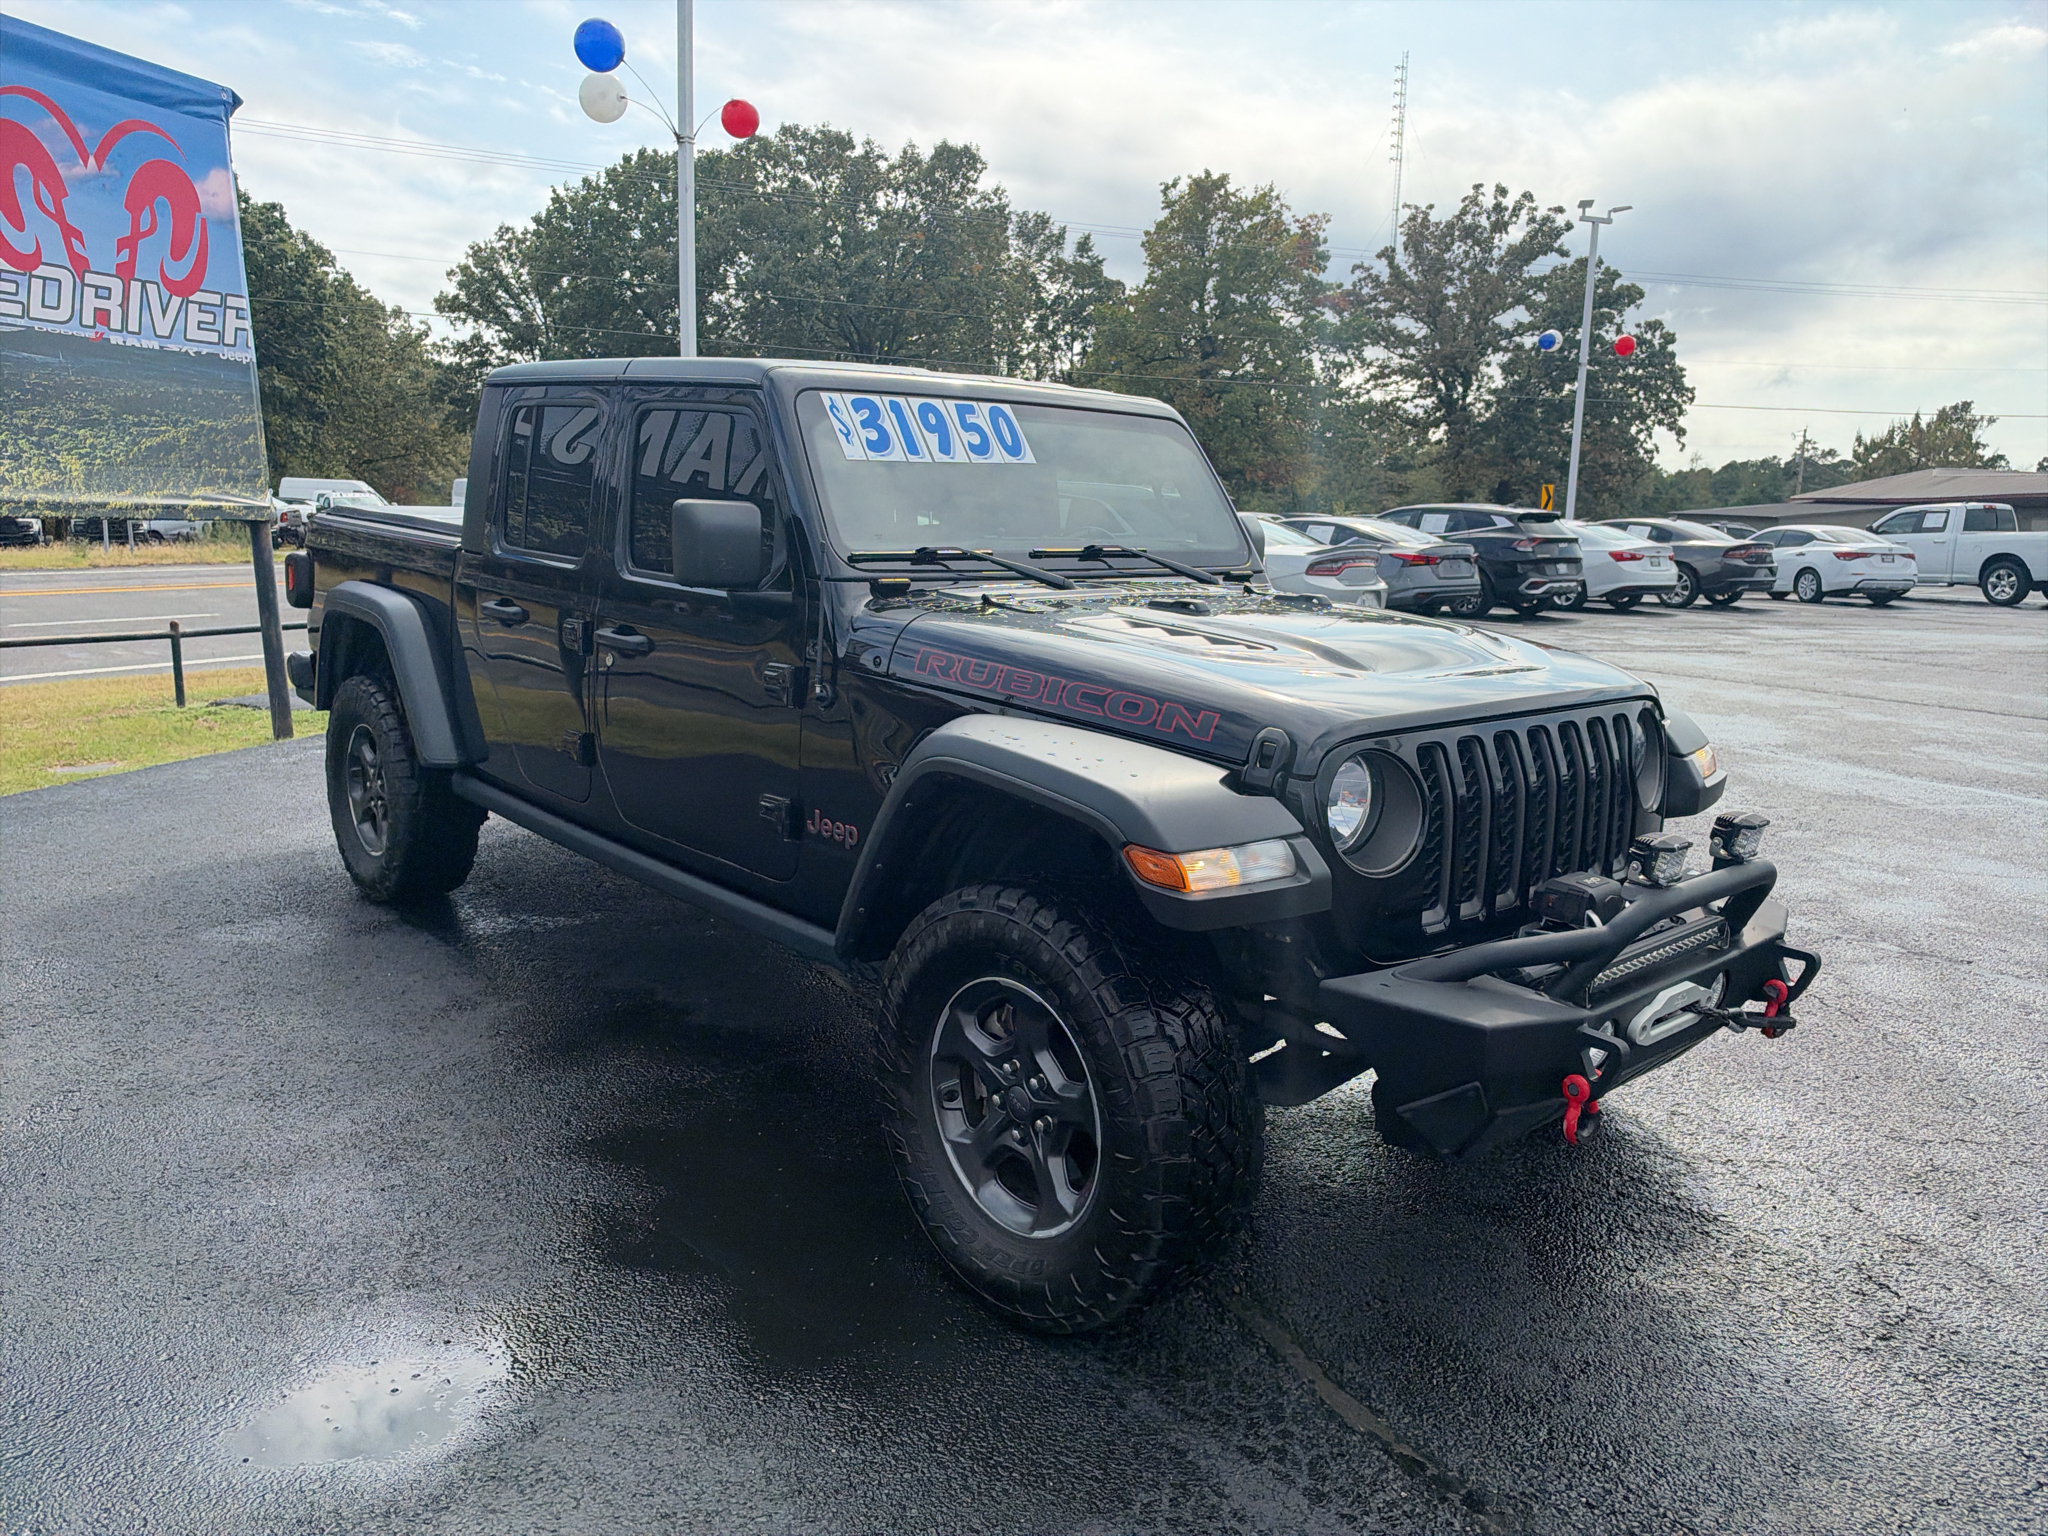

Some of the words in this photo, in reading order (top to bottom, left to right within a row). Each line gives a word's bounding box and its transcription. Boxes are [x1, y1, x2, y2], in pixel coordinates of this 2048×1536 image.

[110, 335, 160, 350] RAM
[219, 347, 250, 364] Jeep
[828, 395, 1026, 461] $31950
[914, 647, 1221, 742] RUBICON
[806, 808, 859, 850] Jeep
